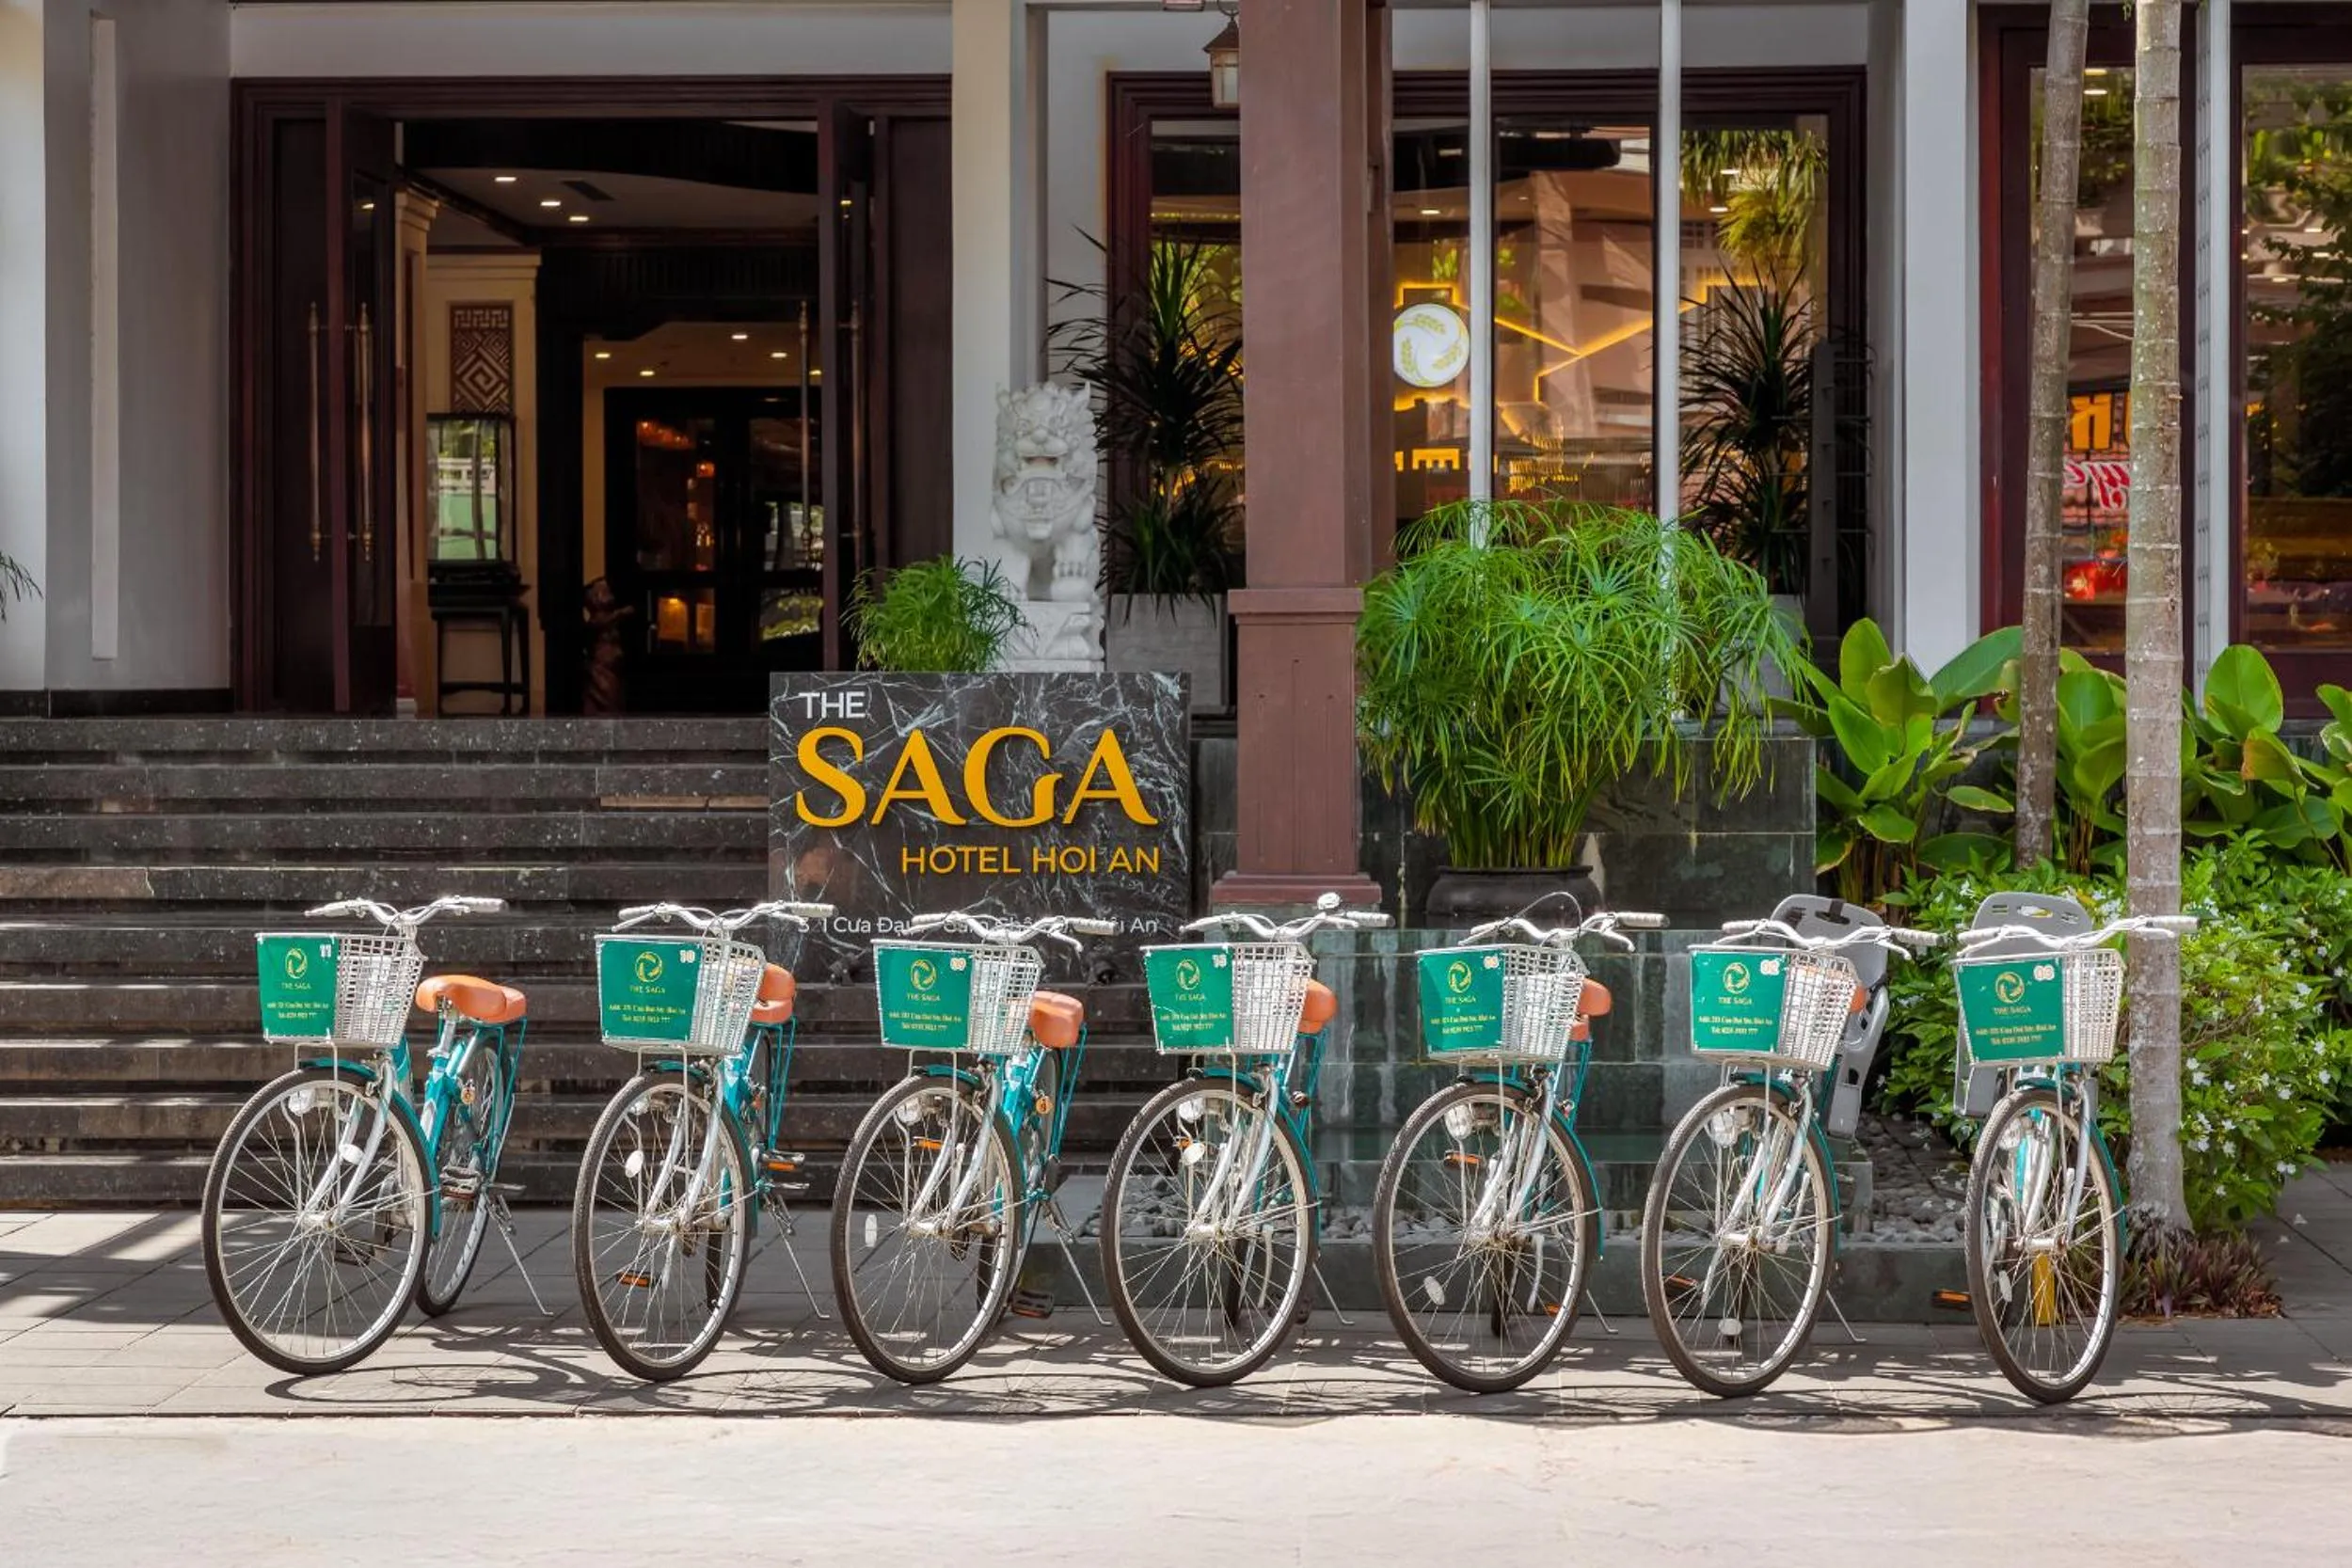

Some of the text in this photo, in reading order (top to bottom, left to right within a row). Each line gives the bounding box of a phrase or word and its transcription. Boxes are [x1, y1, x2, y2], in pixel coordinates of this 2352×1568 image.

[798, 691, 866, 719] THE
[796, 726, 1159, 828] SAGA
[901, 846, 1160, 874] HOTEL HOI AN
[1130, 916, 1158, 933] An
